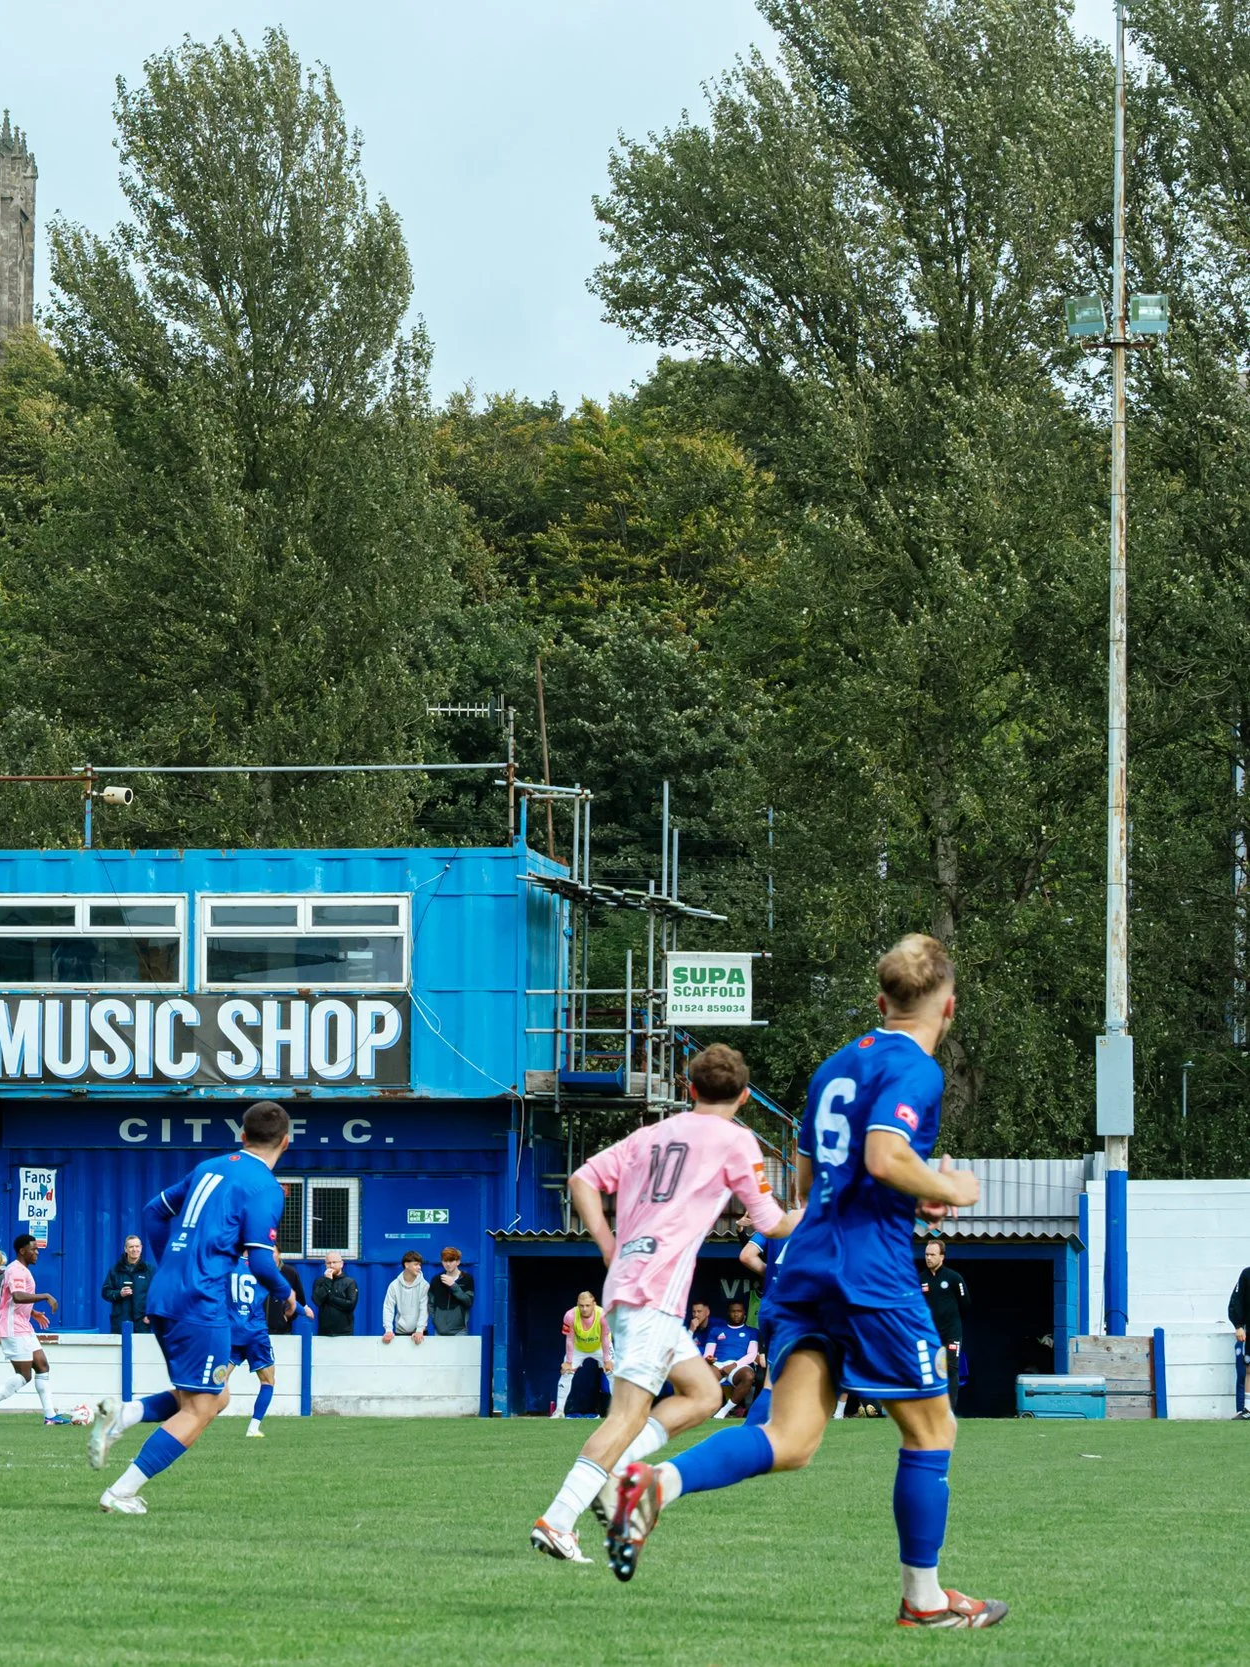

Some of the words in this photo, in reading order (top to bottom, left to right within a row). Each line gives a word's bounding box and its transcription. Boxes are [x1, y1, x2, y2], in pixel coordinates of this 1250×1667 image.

[672, 966, 746, 985] SUPA
[673, 986, 746, 998] SCAFFOLD
[671, 1004, 704, 1012] 01524
[706, 1004, 746, 1013] 859034
[216, 998, 403, 1081] SHOP
[815, 1077, 857, 1167] 6
[24, 1170, 52, 1184] Fans
[640, 1142, 690, 1203] 10
[22, 1187, 54, 1202] Fund
[181, 1172, 225, 1229] 11
[27, 1204, 49, 1218] Bar
[230, 1272, 258, 1305] 16
